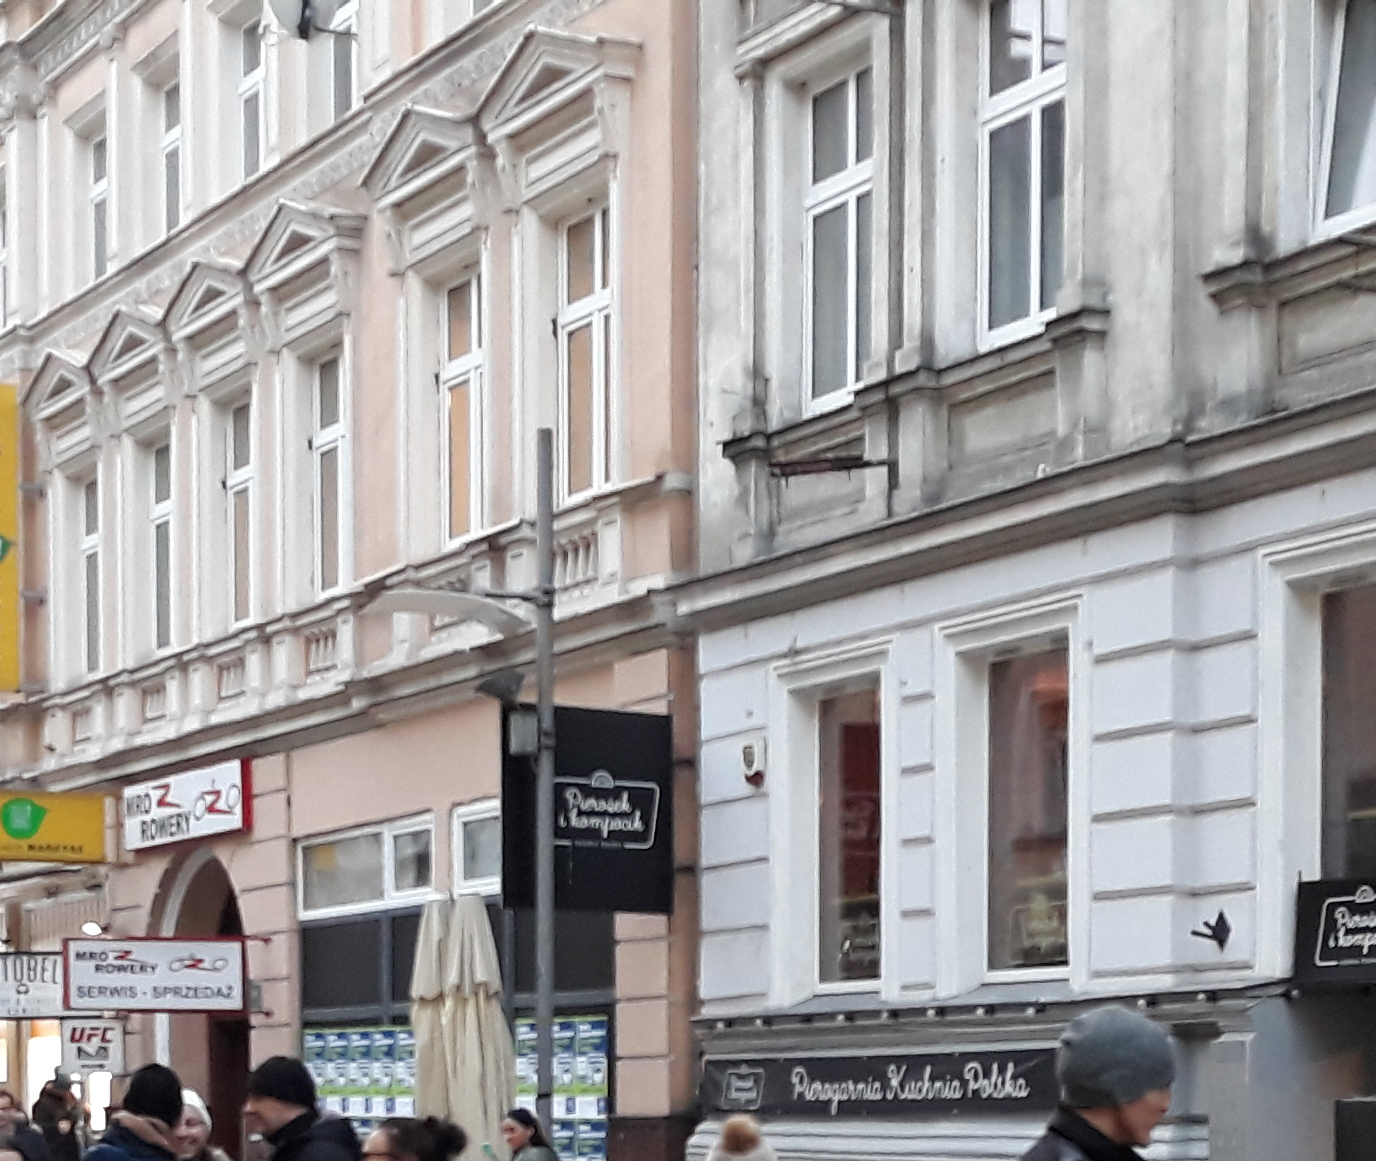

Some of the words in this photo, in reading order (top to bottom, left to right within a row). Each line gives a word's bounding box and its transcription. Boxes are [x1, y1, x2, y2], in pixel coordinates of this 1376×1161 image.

[141, 810, 191, 841] ROWERY
[76, 985, 138, 1000] SERWIS
[70, 1027, 117, 1043] UFC
[791, 1065, 884, 1116] Pierogarnia
[886, 1062, 964, 1100] Kuchnia
[963, 1060, 1031, 1099] Polska
